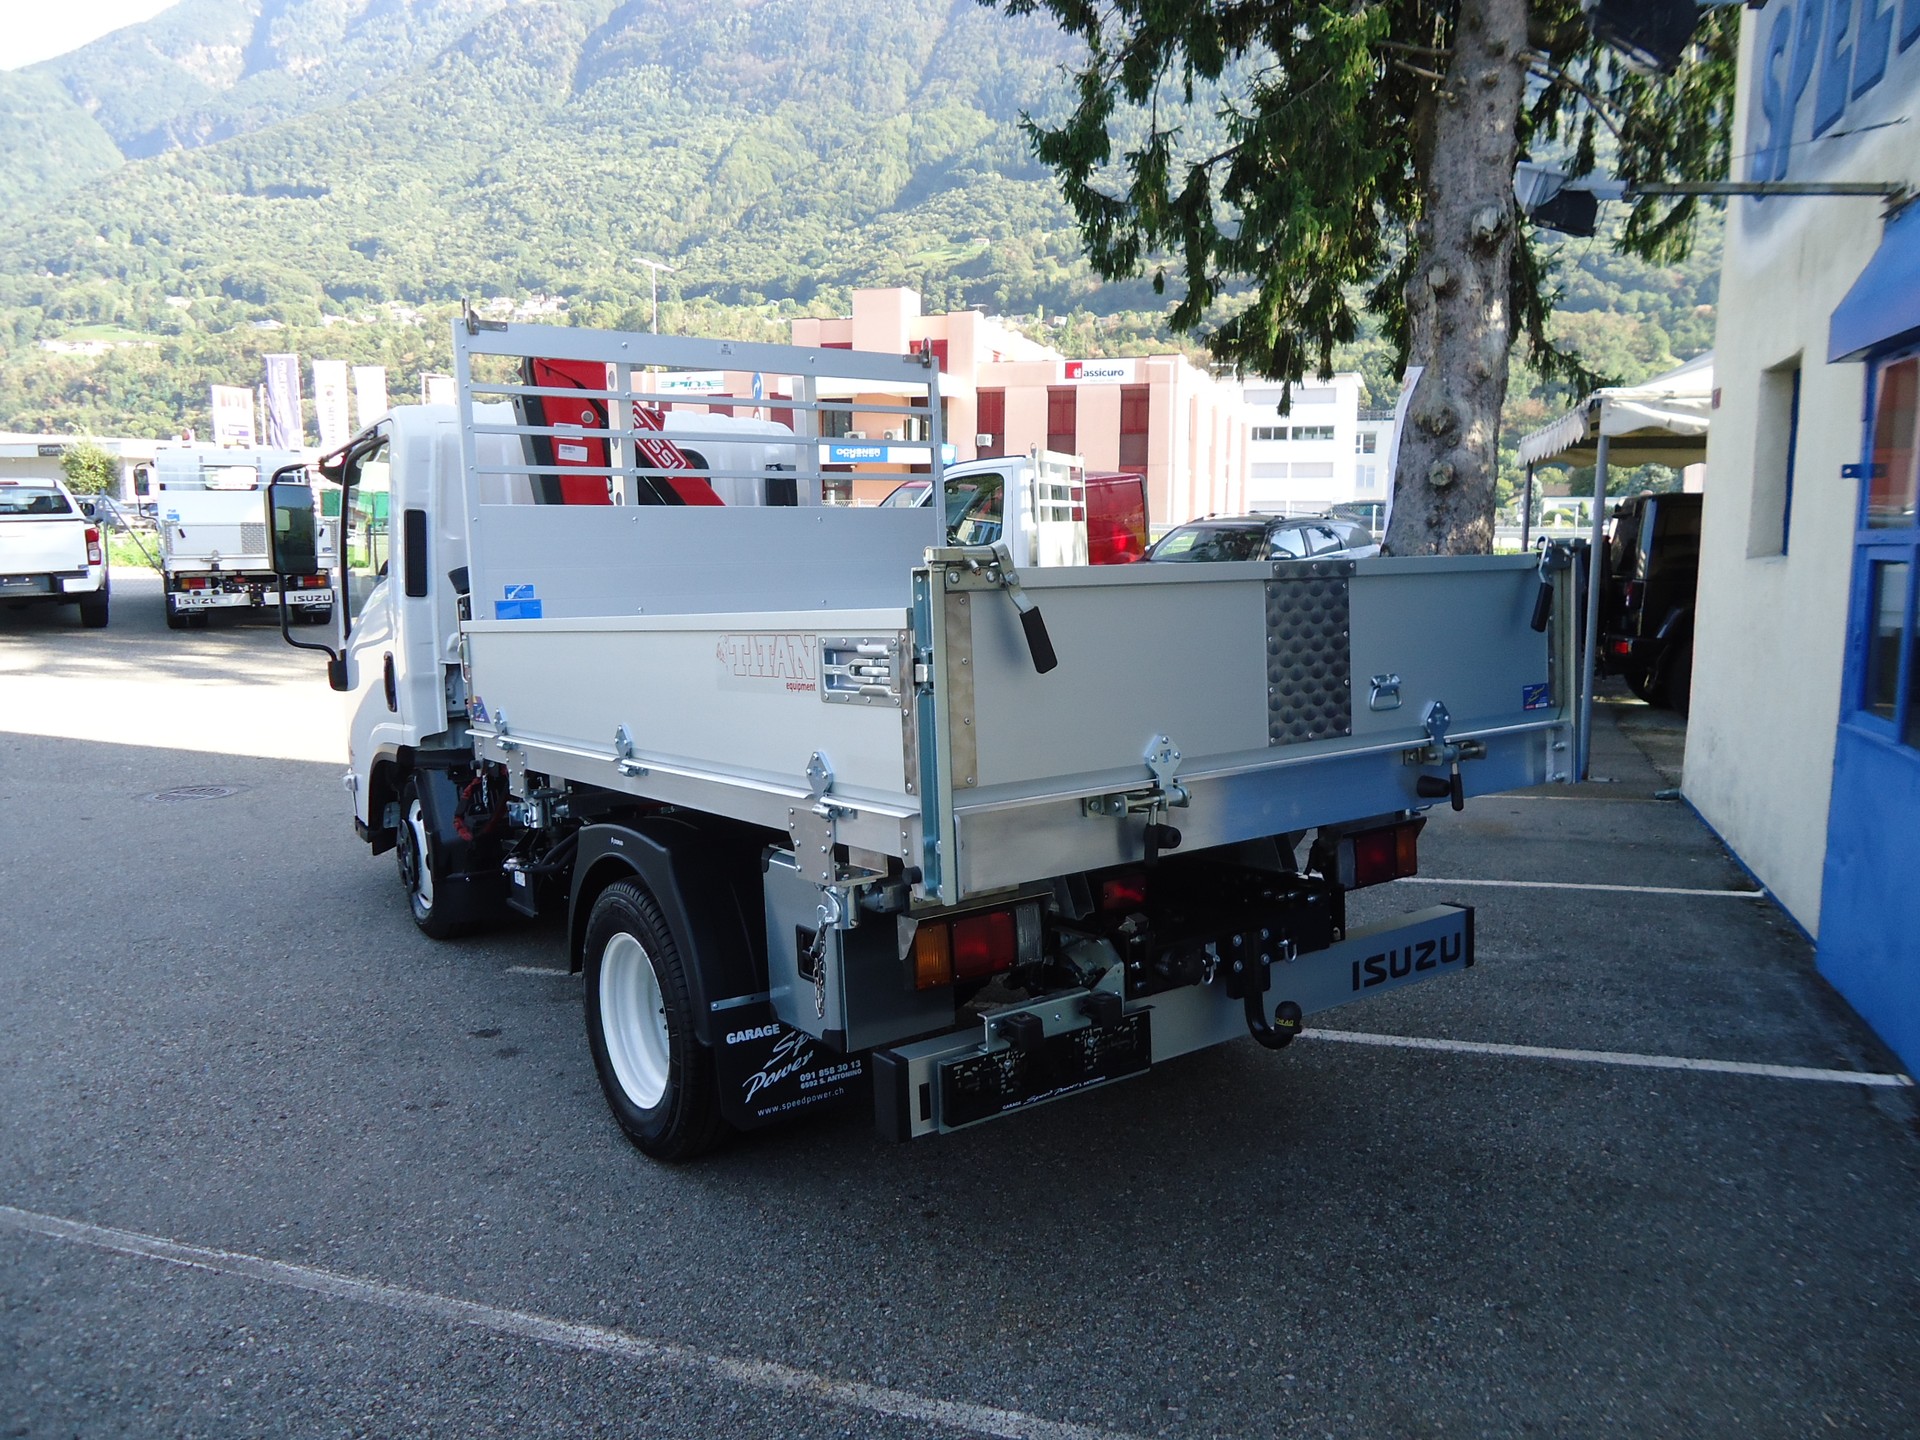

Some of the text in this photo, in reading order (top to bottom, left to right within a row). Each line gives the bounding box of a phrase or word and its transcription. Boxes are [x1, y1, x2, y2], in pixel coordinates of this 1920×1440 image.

[1083, 368, 1124, 377] assicuro
[293, 594, 331, 602] ISUZU
[728, 634, 816, 680] TITAN
[786, 682, 816, 692] equipment
[1352, 932, 1461, 991] ISUZU
[726, 1023, 780, 1045] GARAGE
[741, 1050, 814, 1104] Power
[799, 1059, 862, 1082] 091 858 30 13
[800, 1080, 818, 1089] 6592
[827, 1068, 863, 1083] ANTONINO
[757, 1086, 845, 1117] www.speedpower.ch
